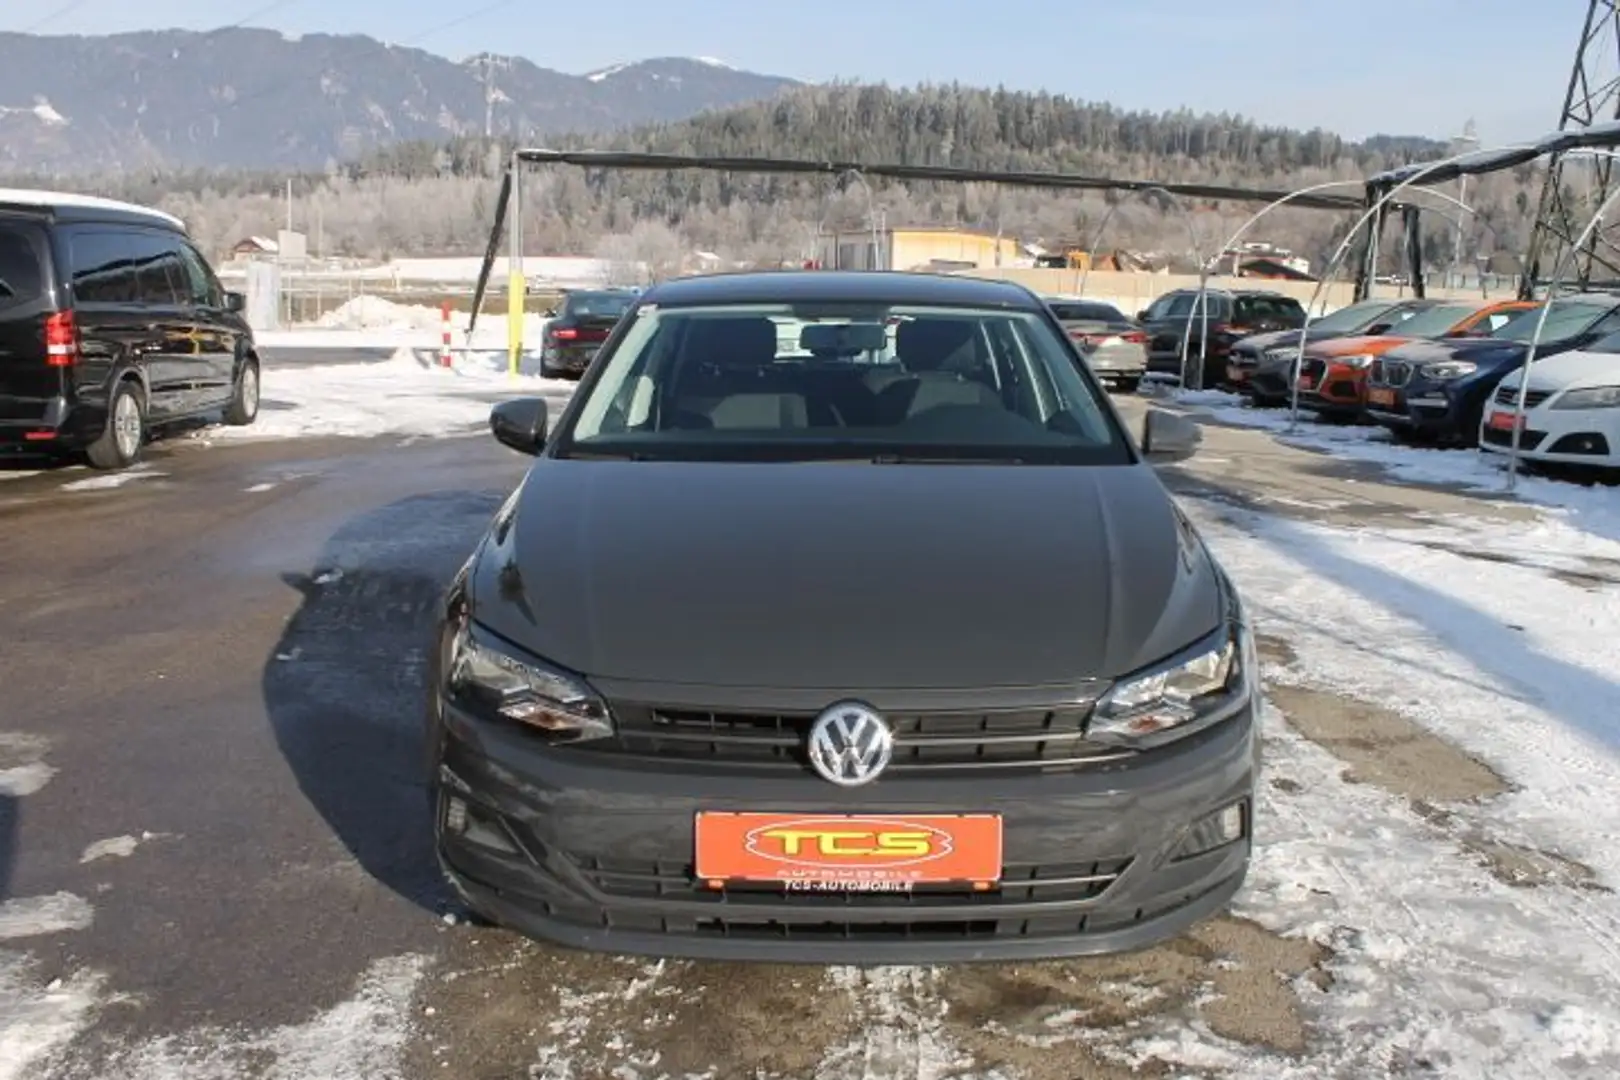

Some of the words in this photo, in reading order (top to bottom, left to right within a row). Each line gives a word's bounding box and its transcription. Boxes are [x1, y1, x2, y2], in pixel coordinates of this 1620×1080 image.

[811, 706, 890, 784] VW
[761, 829, 933, 856] TCS
[776, 869, 923, 878] AUTOMOBILE
[783, 879, 914, 891] TCS-AUTOMOBILE
